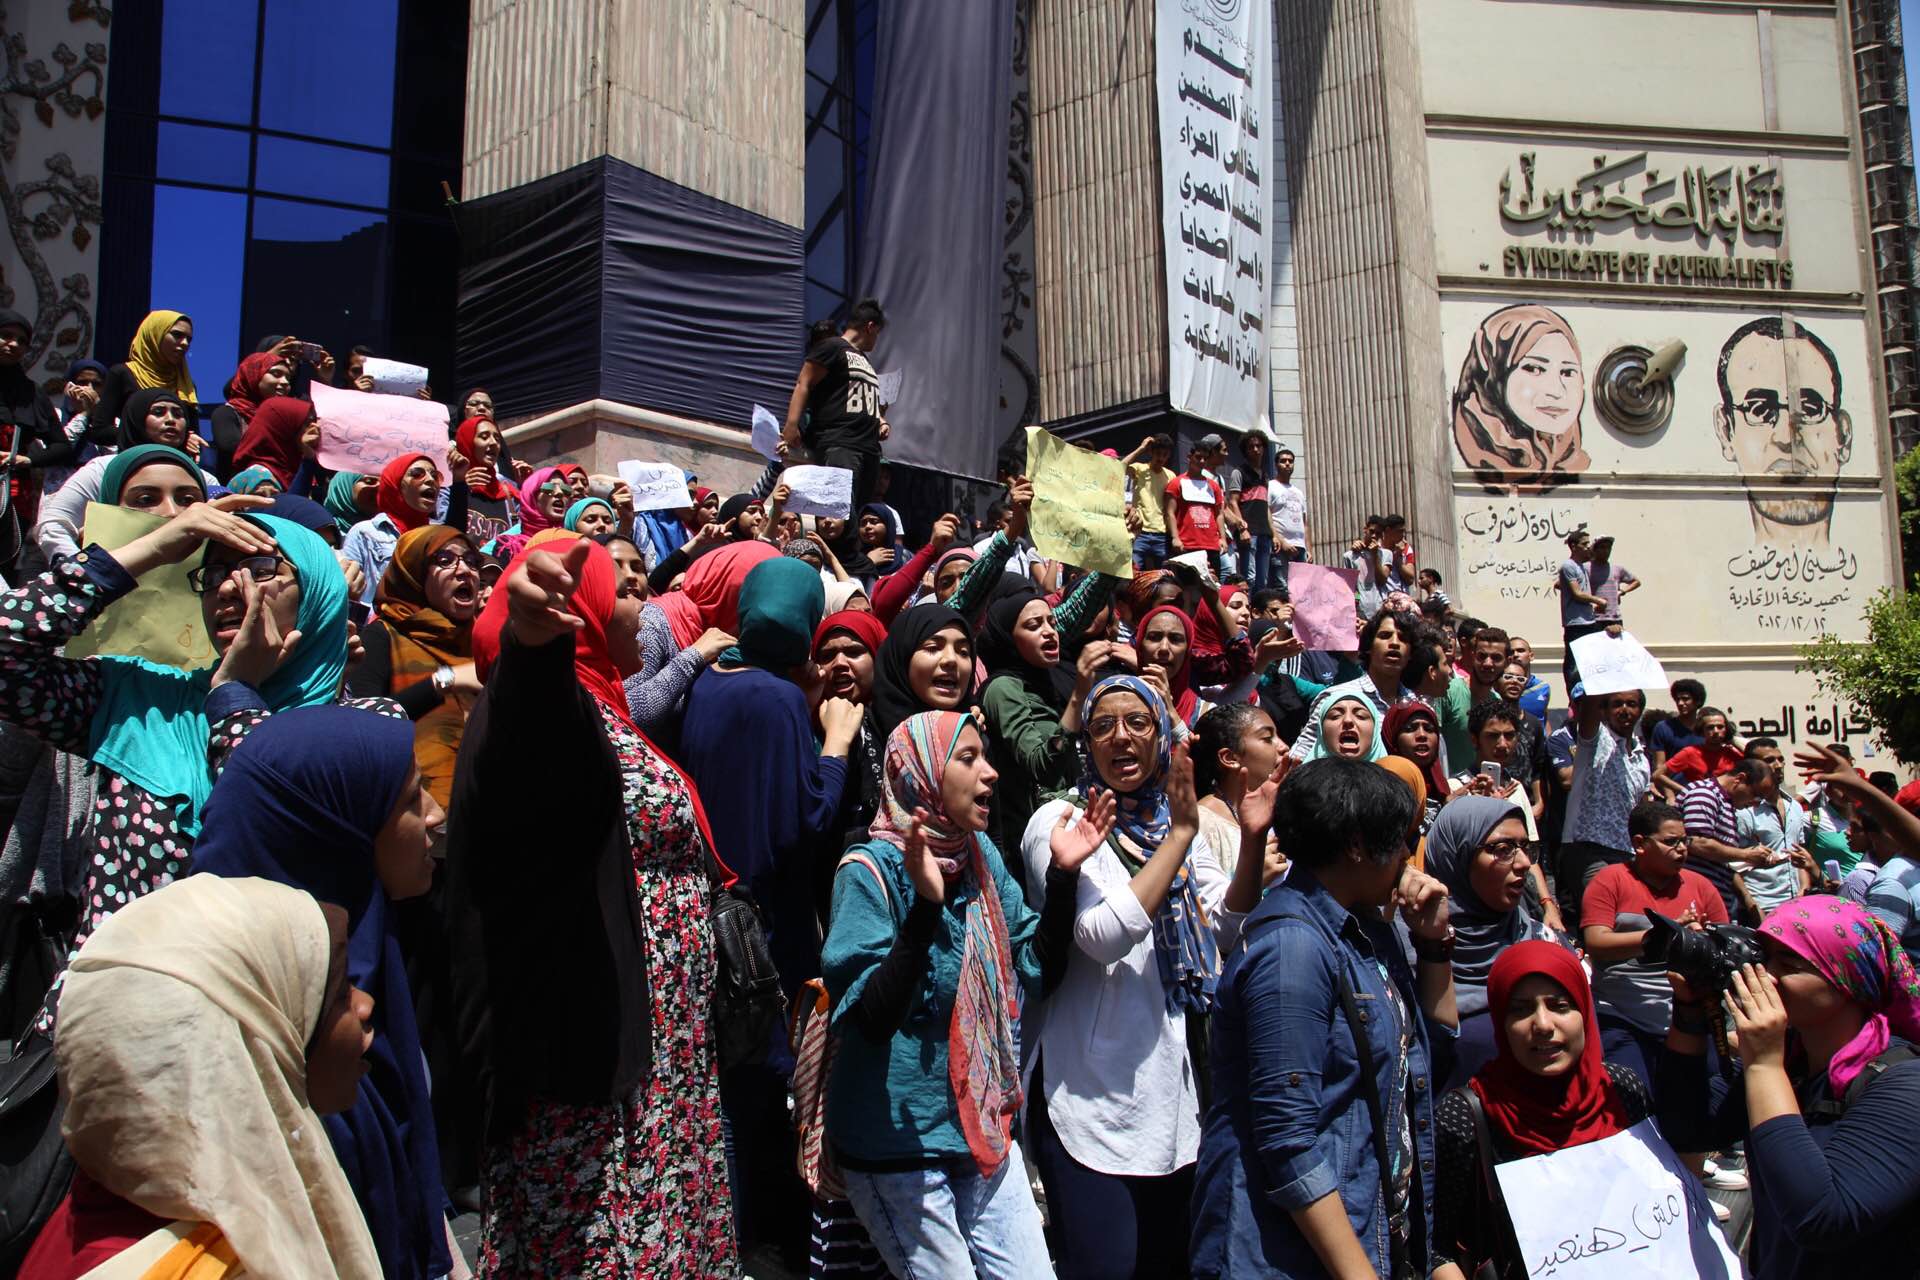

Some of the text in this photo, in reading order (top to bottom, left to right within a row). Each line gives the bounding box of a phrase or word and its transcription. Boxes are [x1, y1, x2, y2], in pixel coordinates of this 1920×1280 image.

[1178, 72, 1236, 122] الصحفيين
[1179, 116, 1218, 161] العزاء
[1500, 151, 1784, 243] نقابة الصحفيين
[1180, 211, 1233, 266] الضحايا
[1504, 246, 1794, 282] SYNDICATE OF JOURNALISTS
[1183, 268, 1235, 316] حادث
[1463, 502, 1530, 543] أشرف
